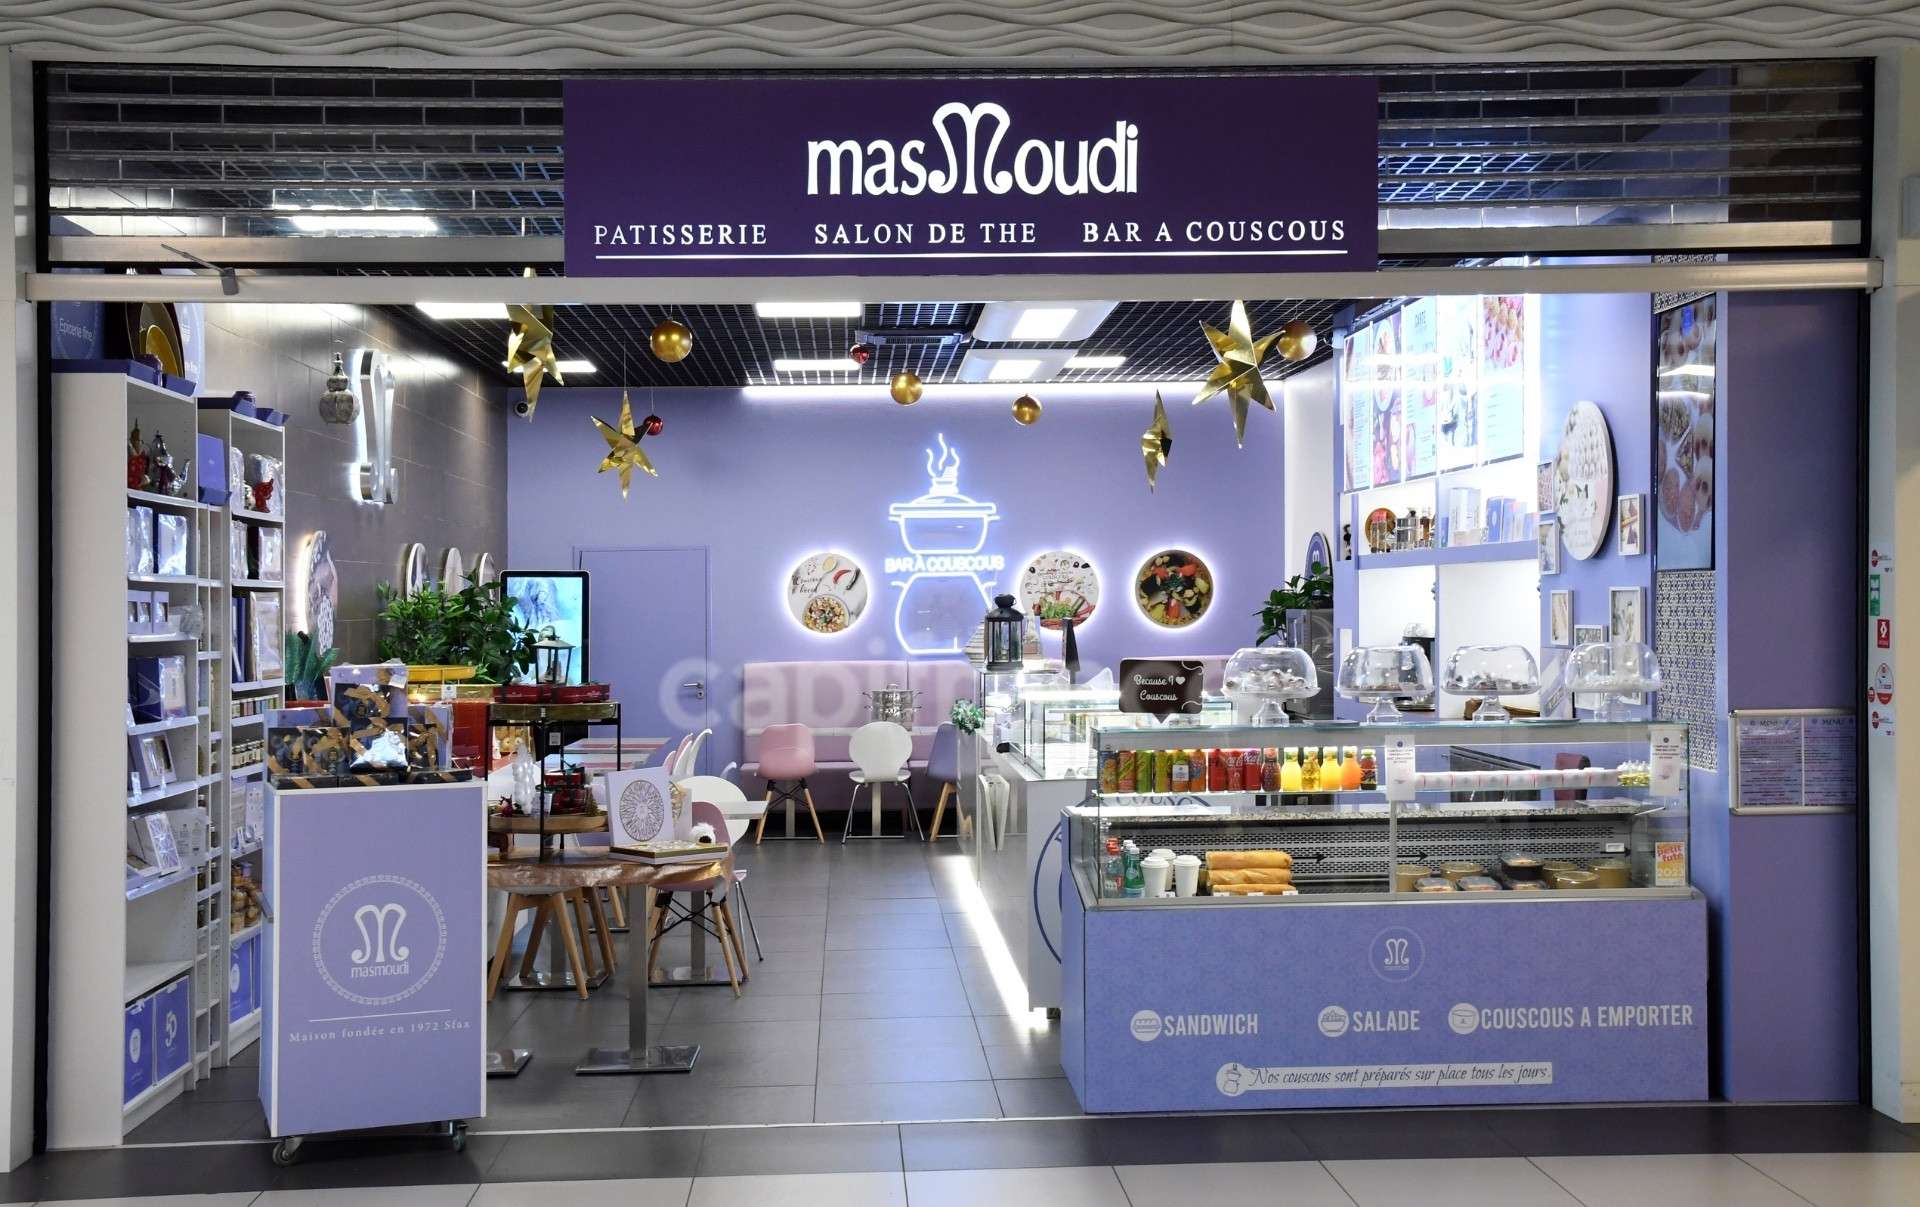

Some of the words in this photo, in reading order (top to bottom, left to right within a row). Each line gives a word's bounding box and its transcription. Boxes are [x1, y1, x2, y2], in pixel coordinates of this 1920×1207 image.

[593, 224, 767, 245] PATISSERIE
[814, 223, 914, 244] SALON
[928, 223, 966, 244] DE
[980, 223, 1036, 243] THE
[1083, 221, 1142, 242] BAR
[1155, 222, 1173, 242] A
[1186, 220, 1345, 242] COUSCOUS
[884, 557, 913, 573] BAR
[927, 555, 1005, 572] COUSCOUS
[1134, 674, 1168, 686] Because
[1140, 690, 1178, 701] Couscous
[351, 962, 409, 978] masmoudi
[1164, 1013, 1259, 1037] SANDWICH
[1352, 1010, 1420, 1032] SALADE
[1481, 1006, 1575, 1030] COUSCOUS
[1580, 1006, 1591, 1027] A
[1597, 1005, 1693, 1027] EMPORTER
[289, 1030, 336, 1042] Maison
[342, 1025, 385, 1038] fondée
[390, 1026, 404, 1034] en
[411, 1022, 439, 1033] 1972
[444, 1020, 470, 1030] Sfax
[1248, 1067, 1280, 1087] Nos
[1282, 1072, 1331, 1085] couscous
[1334, 1069, 1358, 1082] sont
[1360, 1067, 1411, 1087] préparés
[1414, 1070, 1435, 1081] sur
[1436, 1065, 1467, 1085] place
[1471, 1066, 1496, 1080] tous
[1498, 1063, 1514, 1079] les
